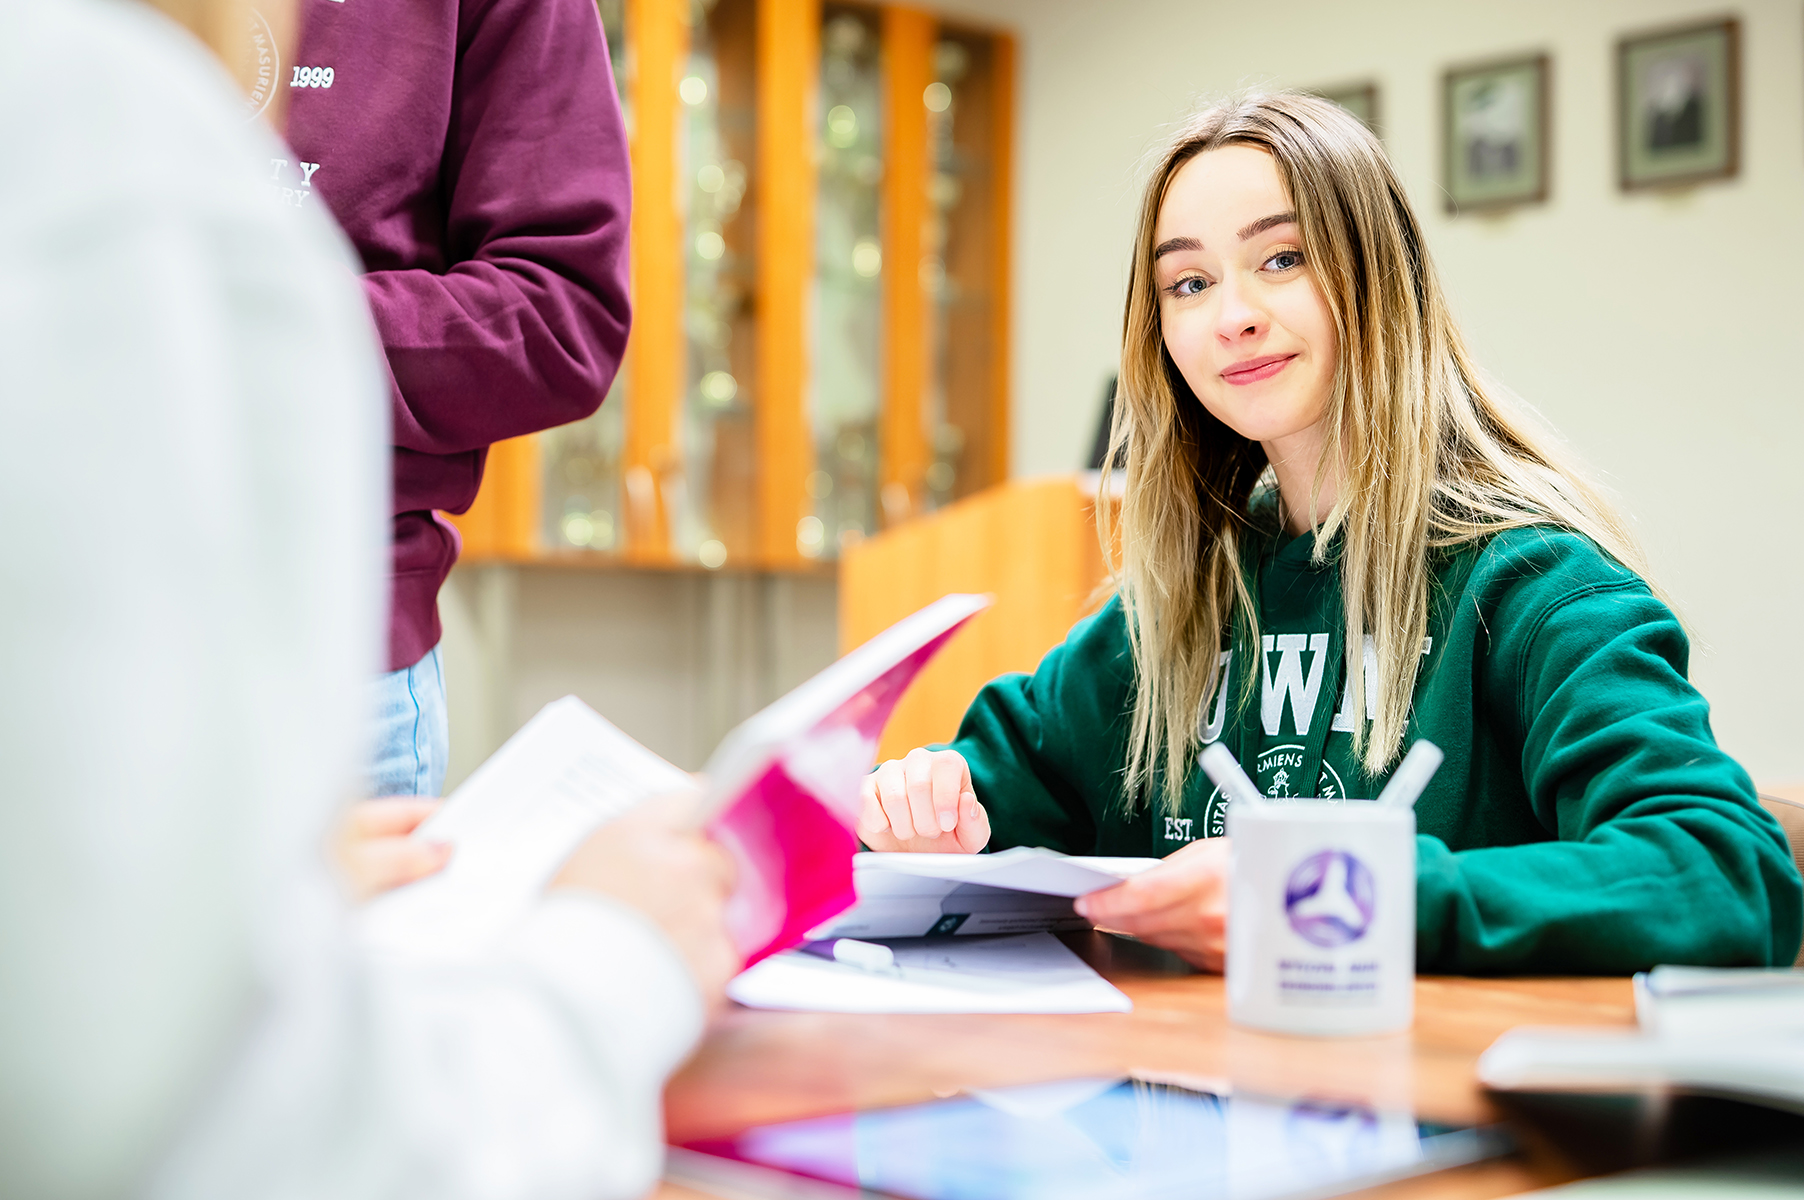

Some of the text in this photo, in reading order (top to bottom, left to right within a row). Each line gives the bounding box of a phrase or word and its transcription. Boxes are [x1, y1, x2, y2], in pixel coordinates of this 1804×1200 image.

[244, 33, 271, 111] MASURIEN
[290, 66, 335, 88] 1999
[1164, 816, 1196, 841] EST.
[1212, 791, 1232, 839] SITAS
